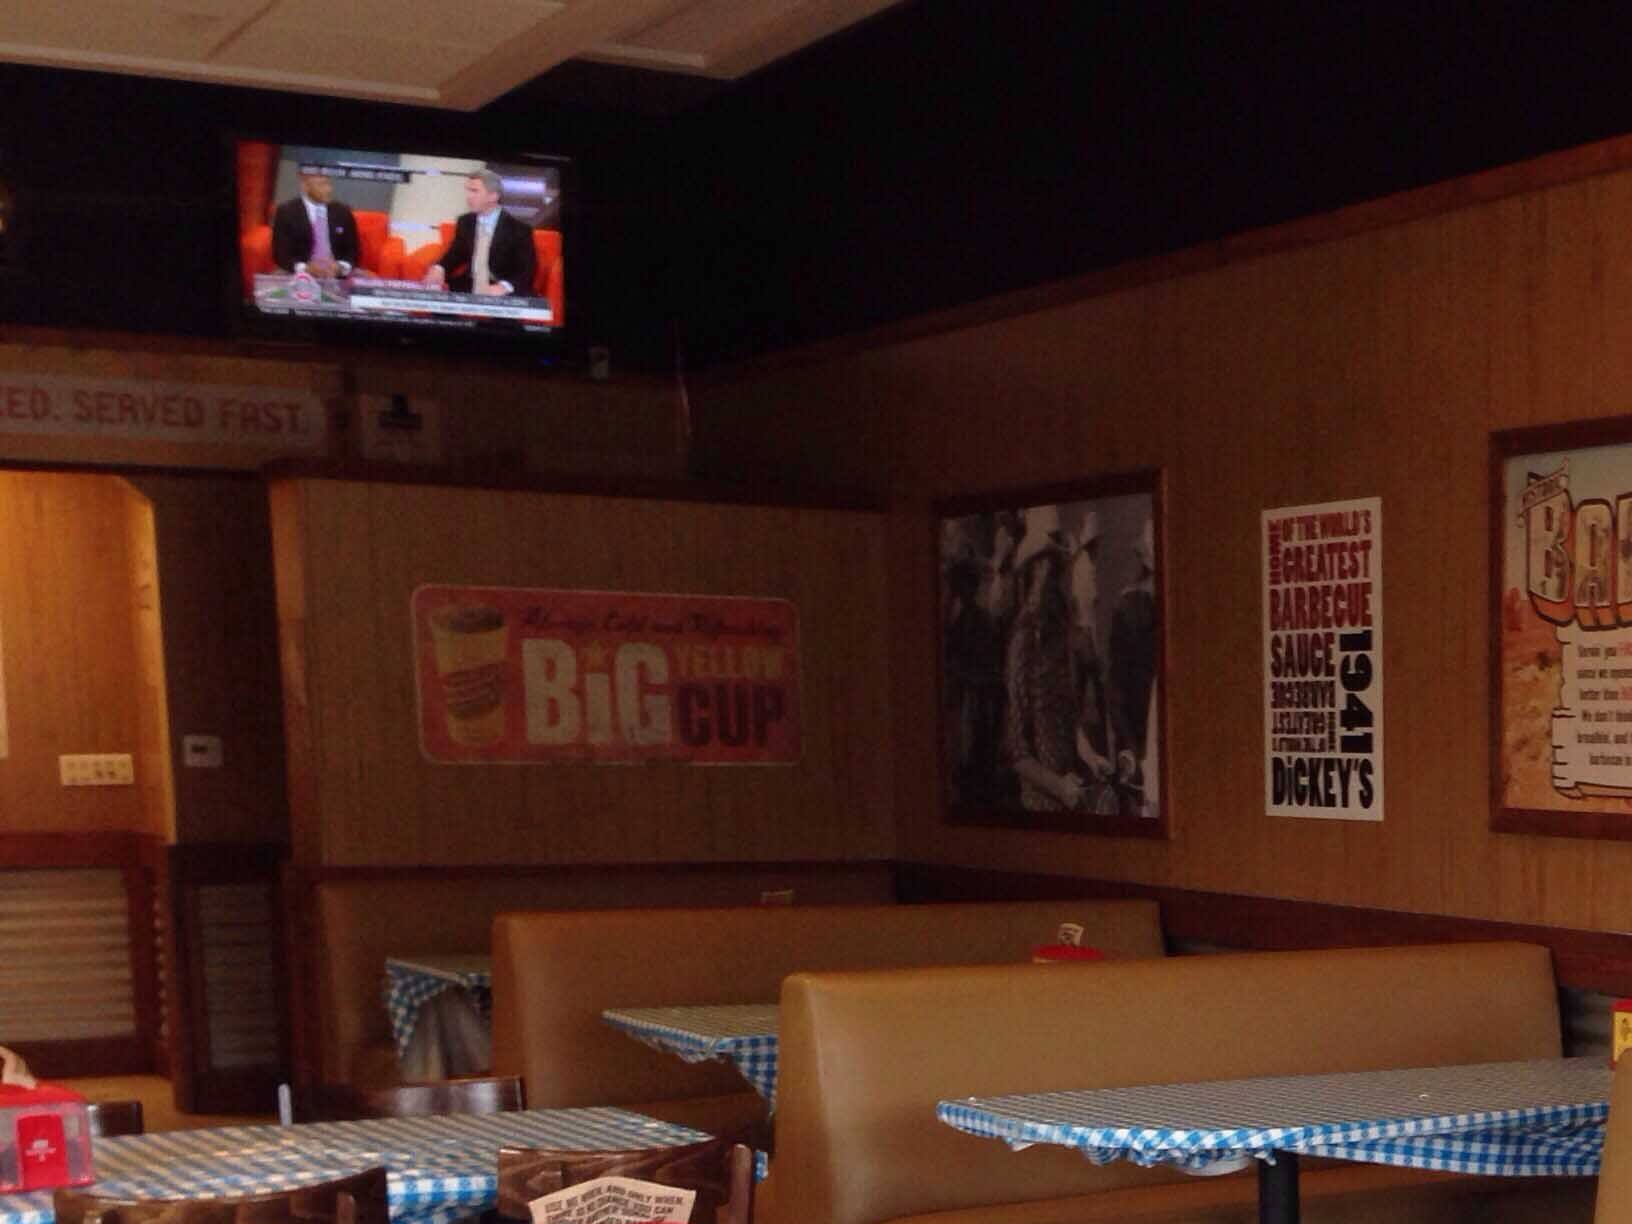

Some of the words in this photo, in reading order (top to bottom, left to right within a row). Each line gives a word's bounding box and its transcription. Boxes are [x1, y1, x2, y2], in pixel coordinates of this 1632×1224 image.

[73, 391, 206, 429] SERVED
[1282, 539, 1372, 583] GREATEST
[1269, 582, 1373, 631] BARBECUE
[1270, 632, 1335, 678] SAUCE
[677, 683, 785, 747] CUP
[1340, 629, 1374, 754] 1941
